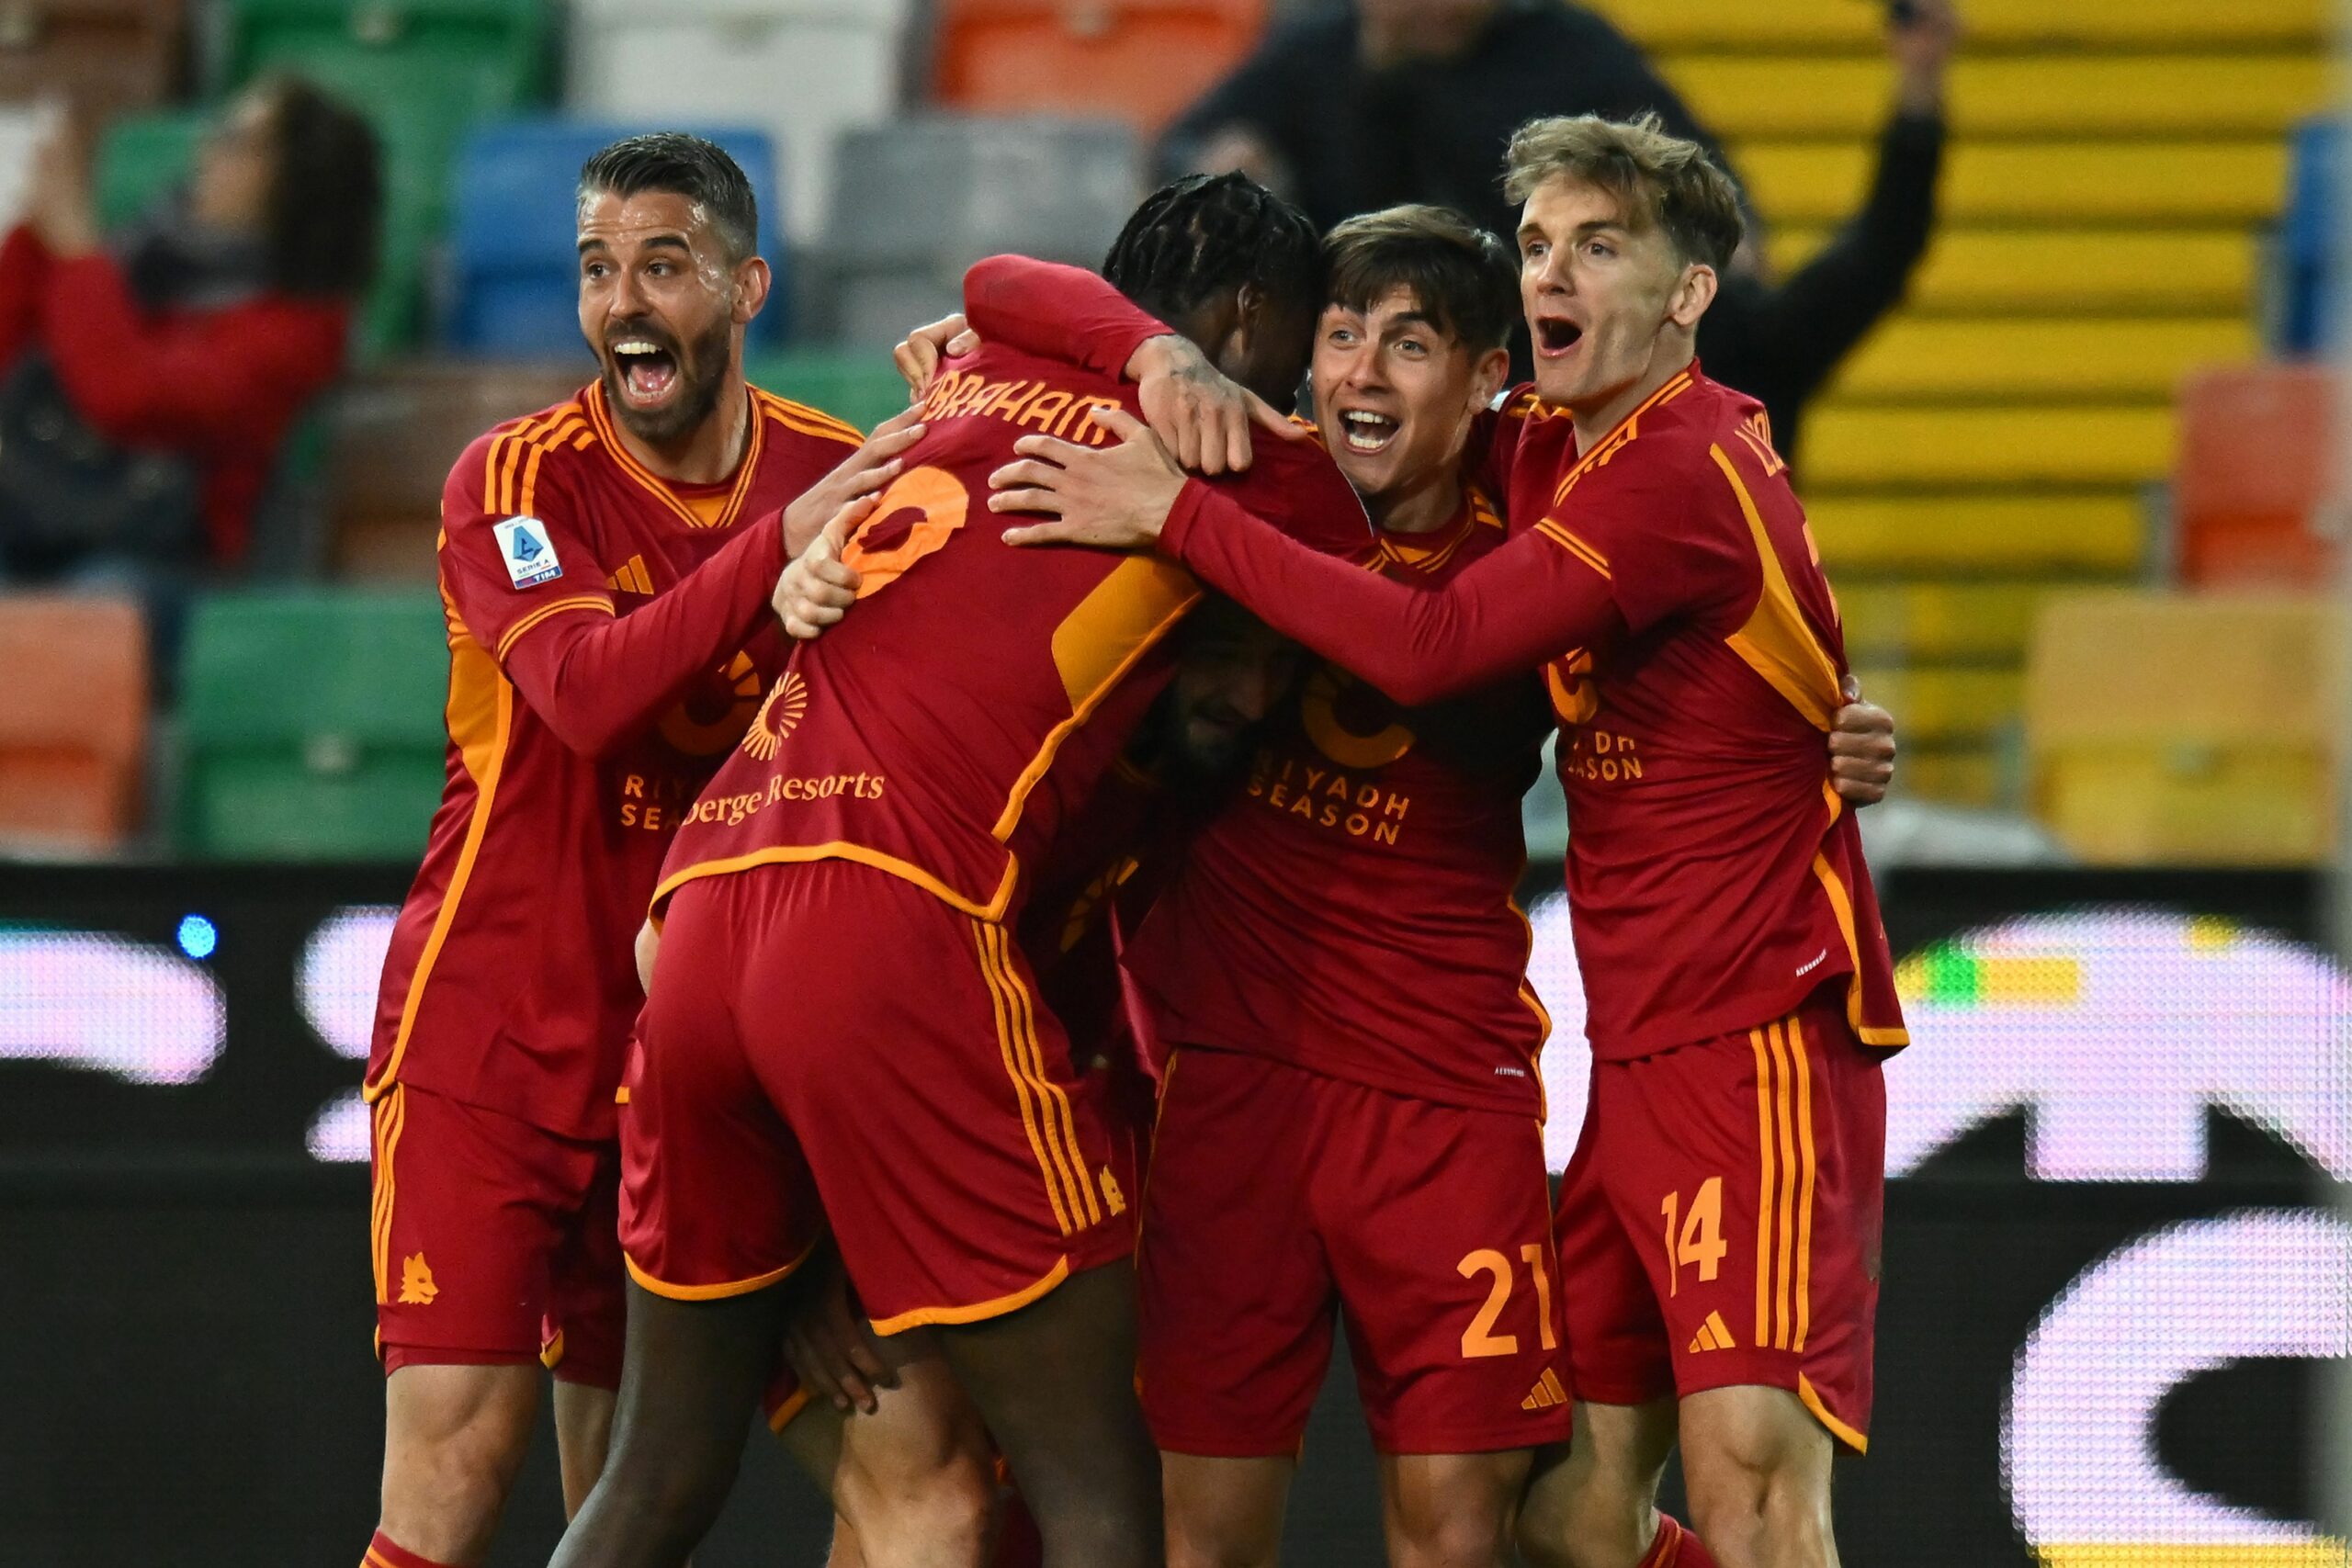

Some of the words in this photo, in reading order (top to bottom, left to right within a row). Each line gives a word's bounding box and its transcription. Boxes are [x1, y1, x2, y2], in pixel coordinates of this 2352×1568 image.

[516, 561, 541, 574] SERIE
[533, 570, 556, 582] TIM
[764, 772, 885, 807] Resorts
[1255, 751, 1409, 820] IYADH
[1661, 1177, 1727, 1298] 14
[1457, 1243, 1556, 1359] 21
